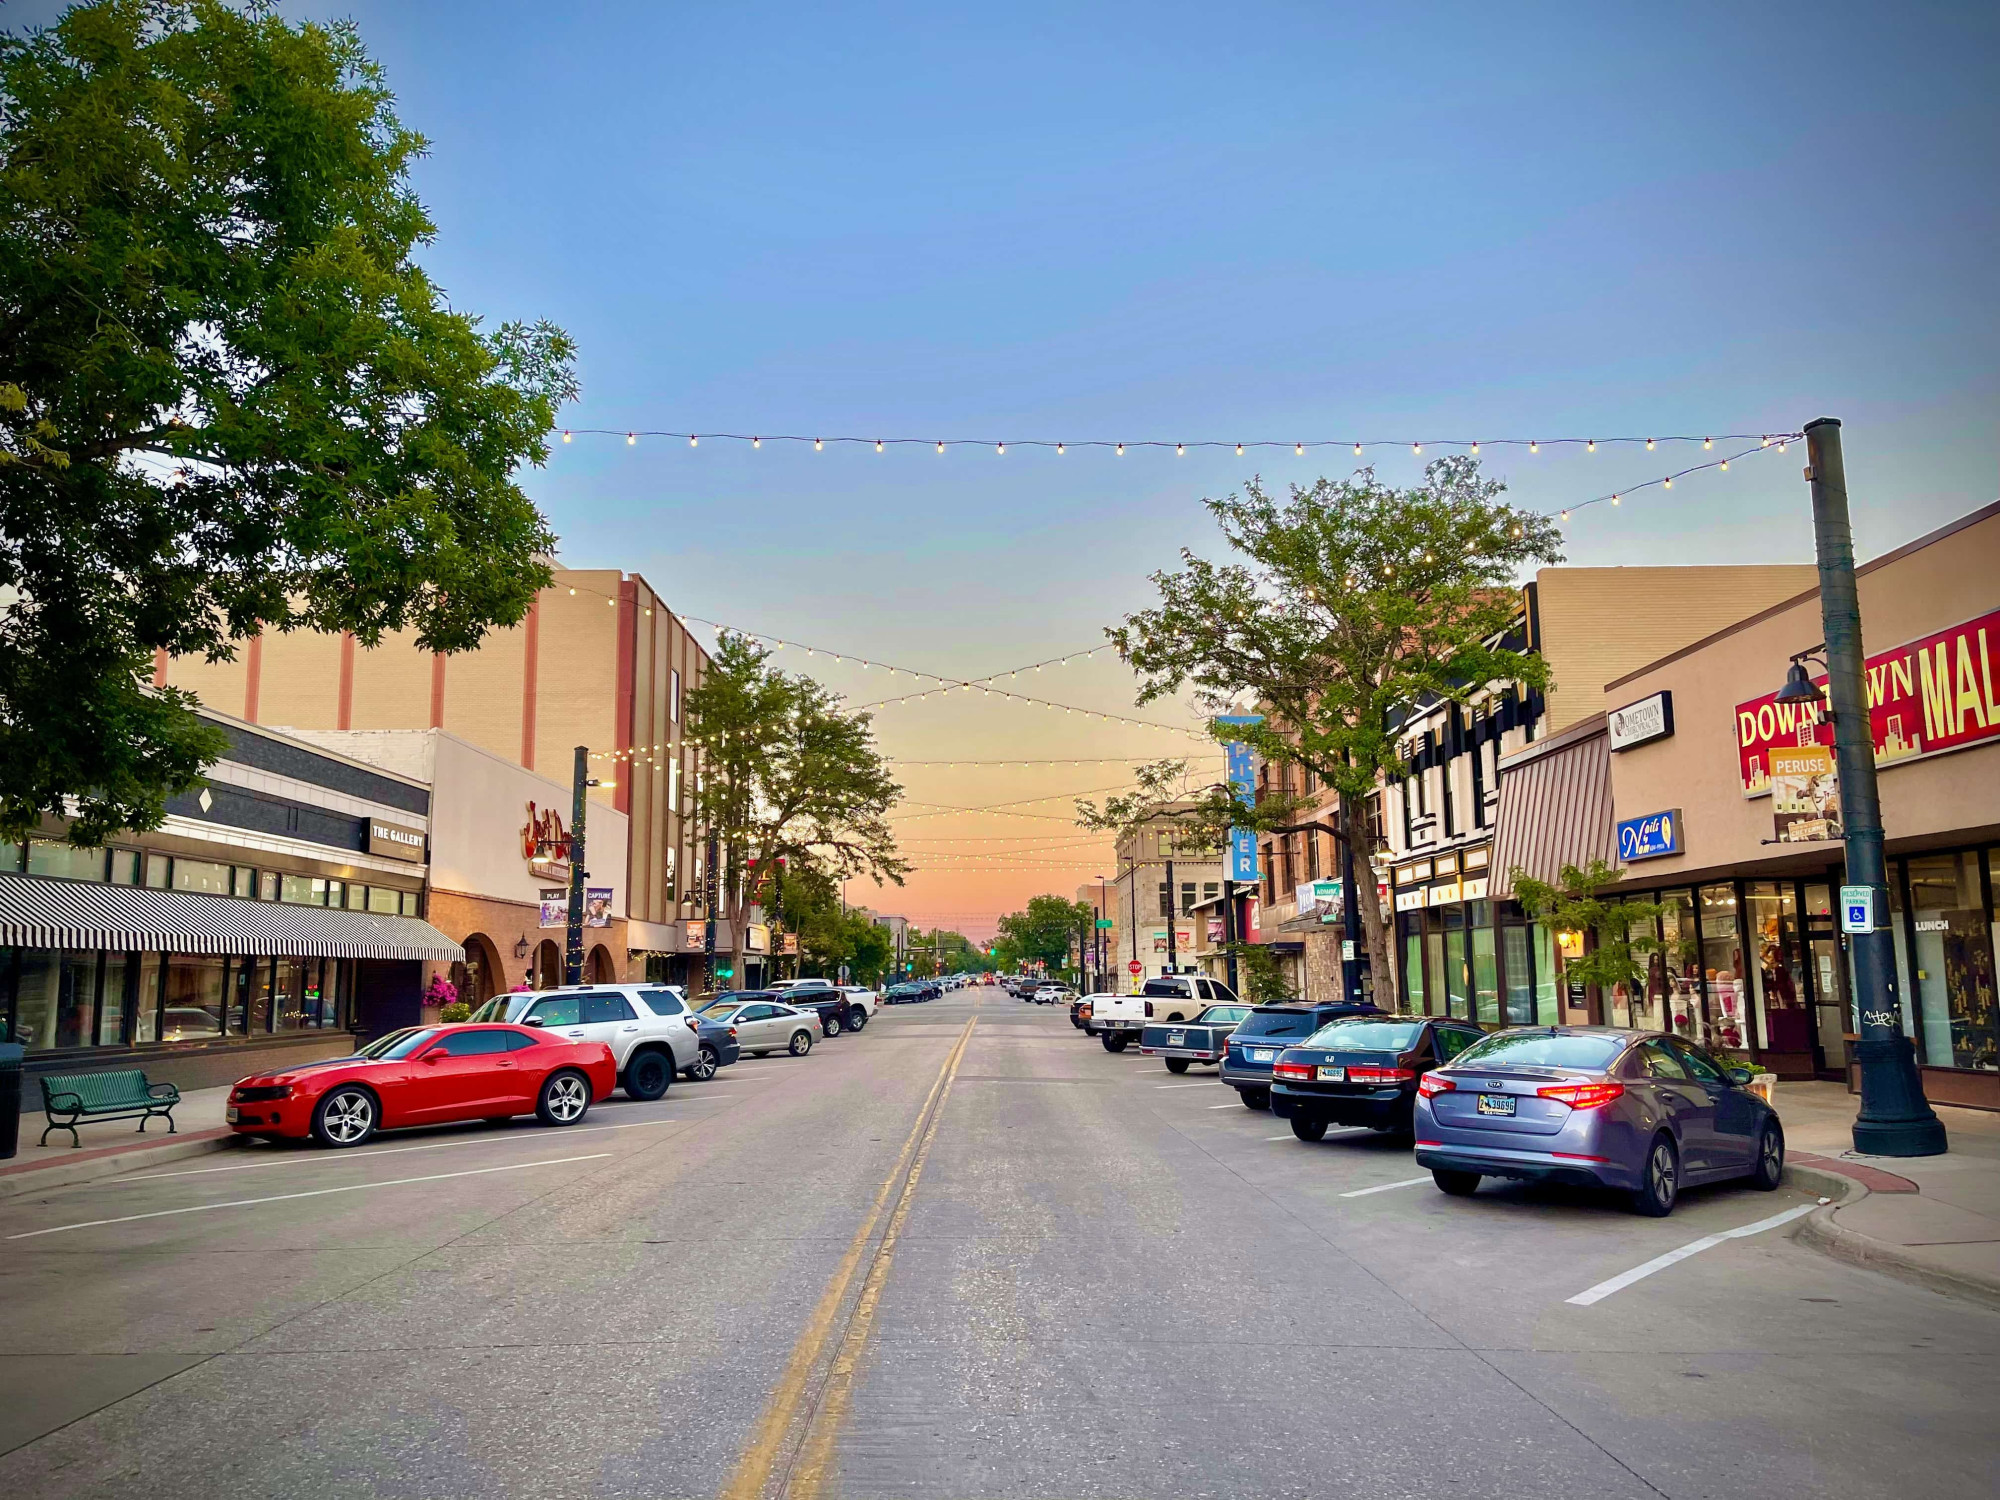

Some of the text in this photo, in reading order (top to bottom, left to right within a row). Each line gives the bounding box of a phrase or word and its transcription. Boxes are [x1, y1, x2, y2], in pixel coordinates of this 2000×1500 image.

[1739, 655, 1914, 748] DOWNTWN
[1776, 758, 1826, 774] PERUSE
[373, 825, 423, 847] THE GALLERY
[1622, 818, 1660, 857] Nails
[1915, 920, 1950, 932] LUNCH
[1492, 1101, 1514, 1111] 39696
